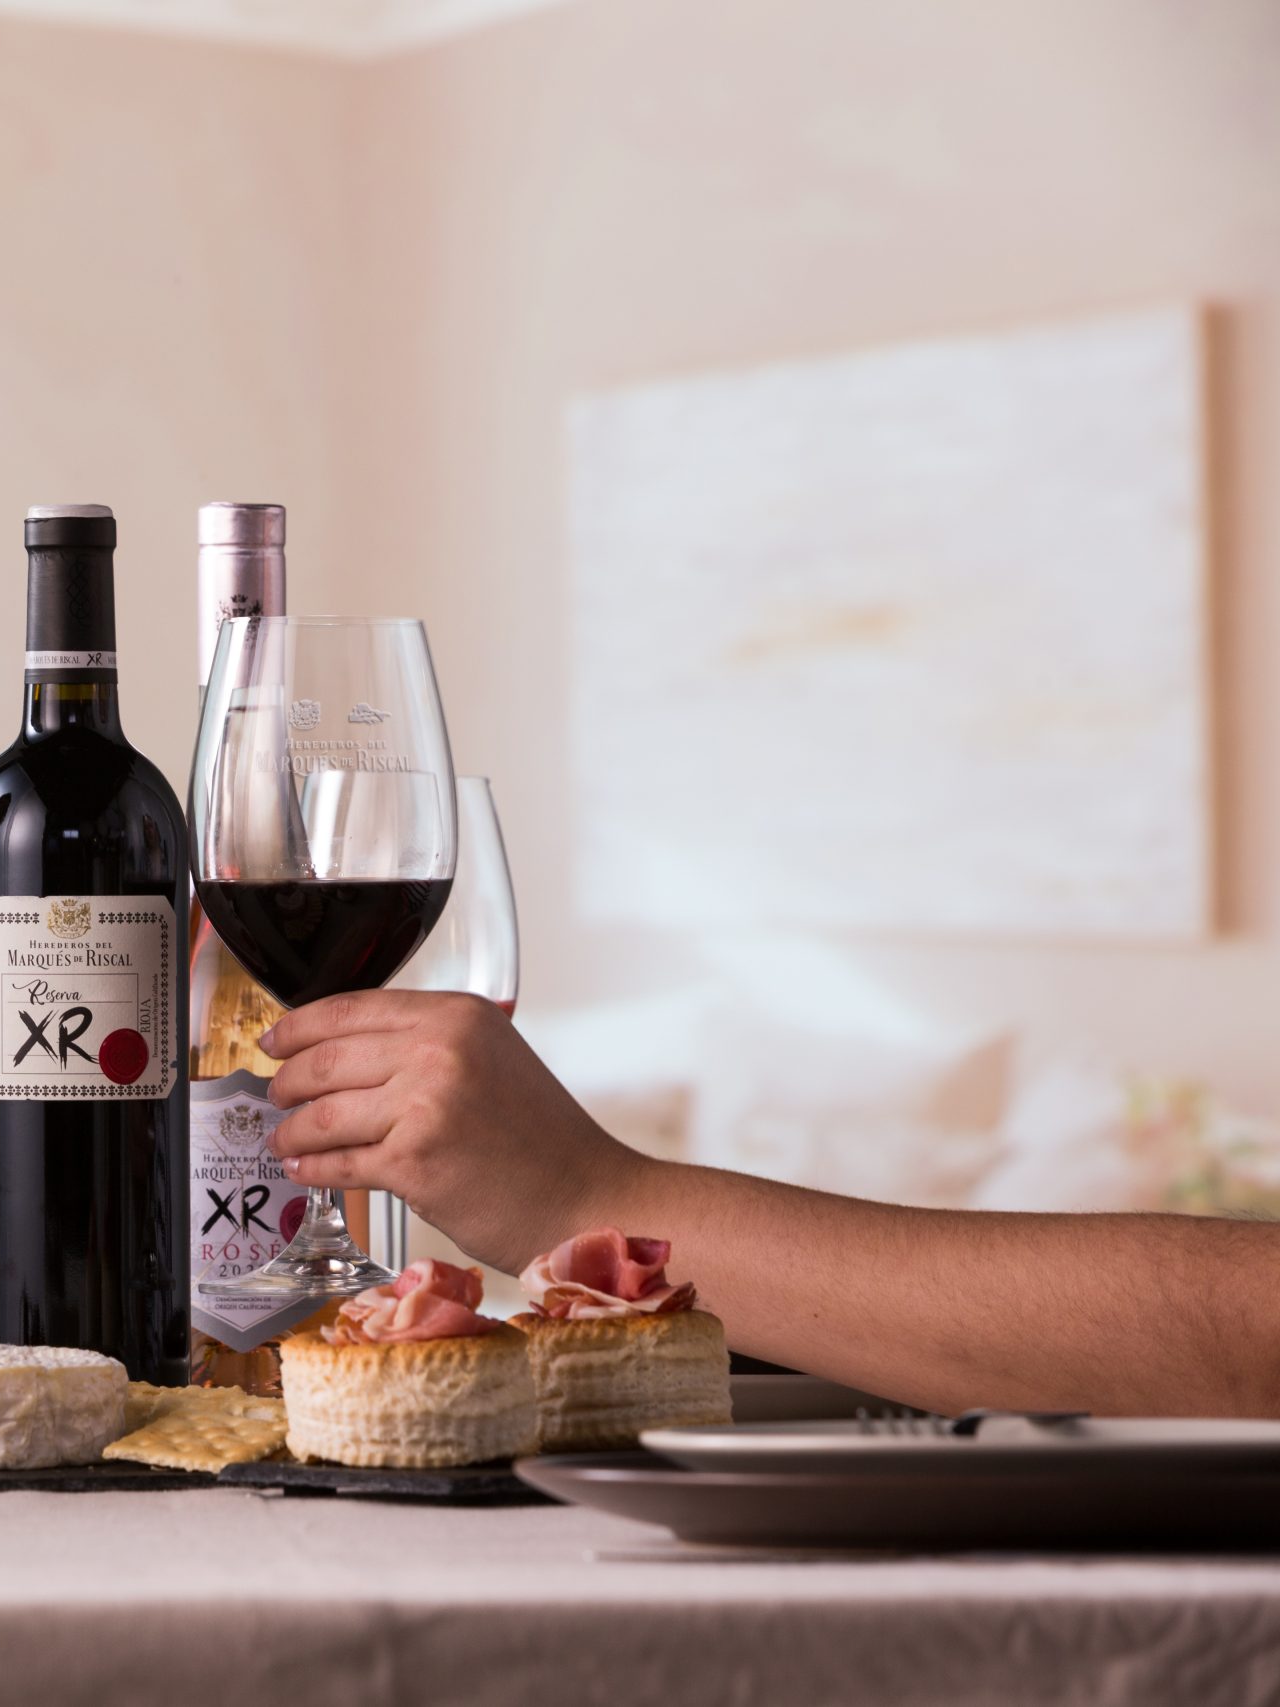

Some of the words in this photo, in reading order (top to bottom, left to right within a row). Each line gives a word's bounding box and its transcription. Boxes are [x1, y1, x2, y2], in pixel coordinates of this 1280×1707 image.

[86, 652, 103, 666] XR
[357, 750, 411, 774] RISCAL
[29, 940, 90, 949] HEREDEROS
[95, 941, 113, 949] DEL
[7, 949, 72, 970] MARQUÉS
[73, 955, 83, 963] DE
[85, 949, 133, 967] RISCAL
[12, 979, 82, 1006] Reserva
[140, 998, 151, 1033] RIOJA
[12, 1006, 100, 1072] XR
[258, 1162, 288, 1180] RISC
[201, 1184, 280, 1240] XR
[202, 1239, 281, 1261] ROSÉ
[219, 1263, 264, 1278] 202
